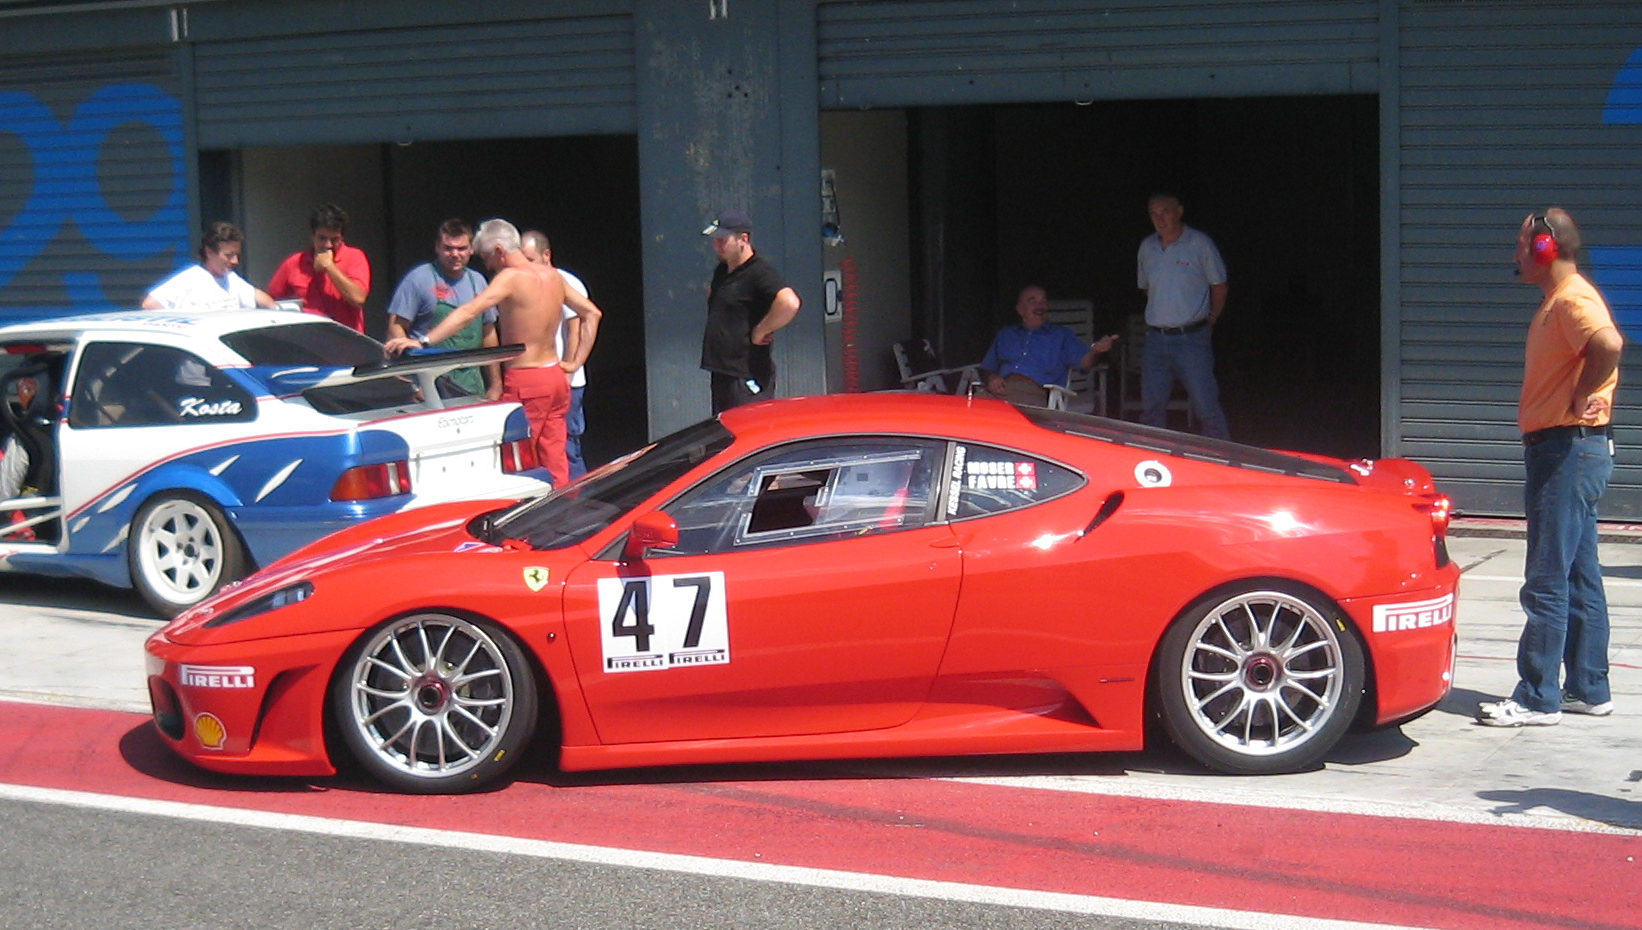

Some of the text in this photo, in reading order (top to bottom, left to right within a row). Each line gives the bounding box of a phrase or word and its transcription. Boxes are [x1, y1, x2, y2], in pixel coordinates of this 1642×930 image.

[179, 396, 243, 417] Kosta
[953, 446, 966, 478] RACING
[966, 461, 1015, 475] MOSER
[968, 475, 1016, 489] FAVRE
[612, 576, 711, 652] 47
[1373, 593, 1454, 632] PIRELLI
[607, 649, 725, 669] PIRELLI PIRELLI
[181, 664, 255, 688] PIRELLI
